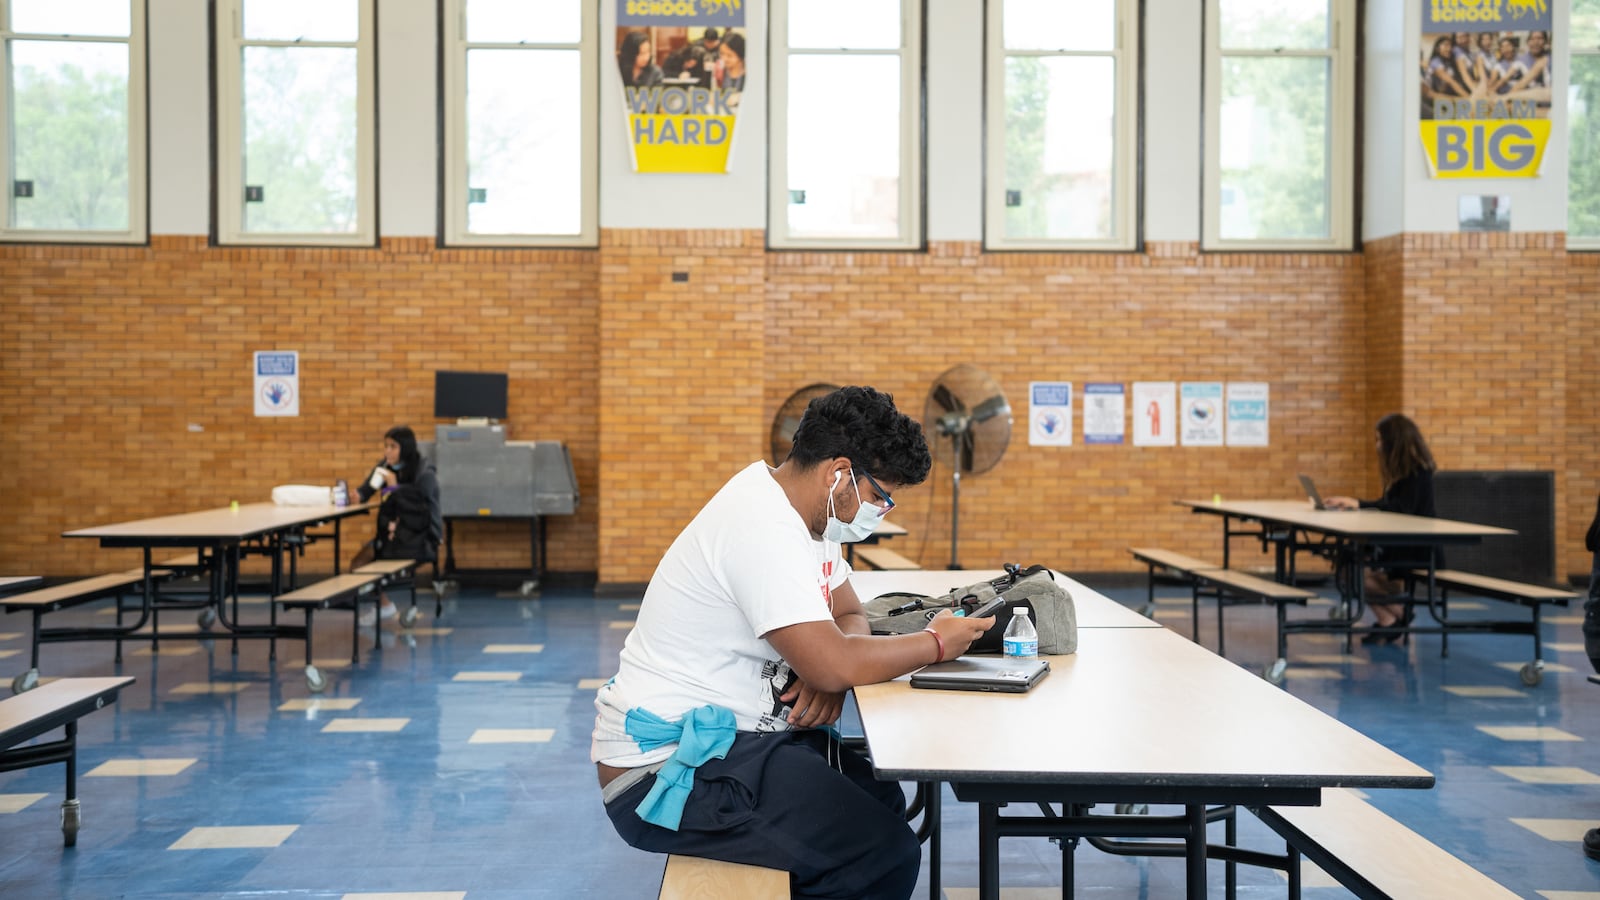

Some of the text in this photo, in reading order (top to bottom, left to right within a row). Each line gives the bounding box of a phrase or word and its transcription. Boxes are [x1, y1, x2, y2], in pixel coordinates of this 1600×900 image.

[626, 0, 697, 16] SCHOOL
[1431, 7, 1501, 22] SCHOOL
[626, 87, 734, 115] WORK
[1435, 99, 1537, 120] DREAM
[634, 118, 727, 145] HARD
[1437, 124, 1536, 171] BIG
